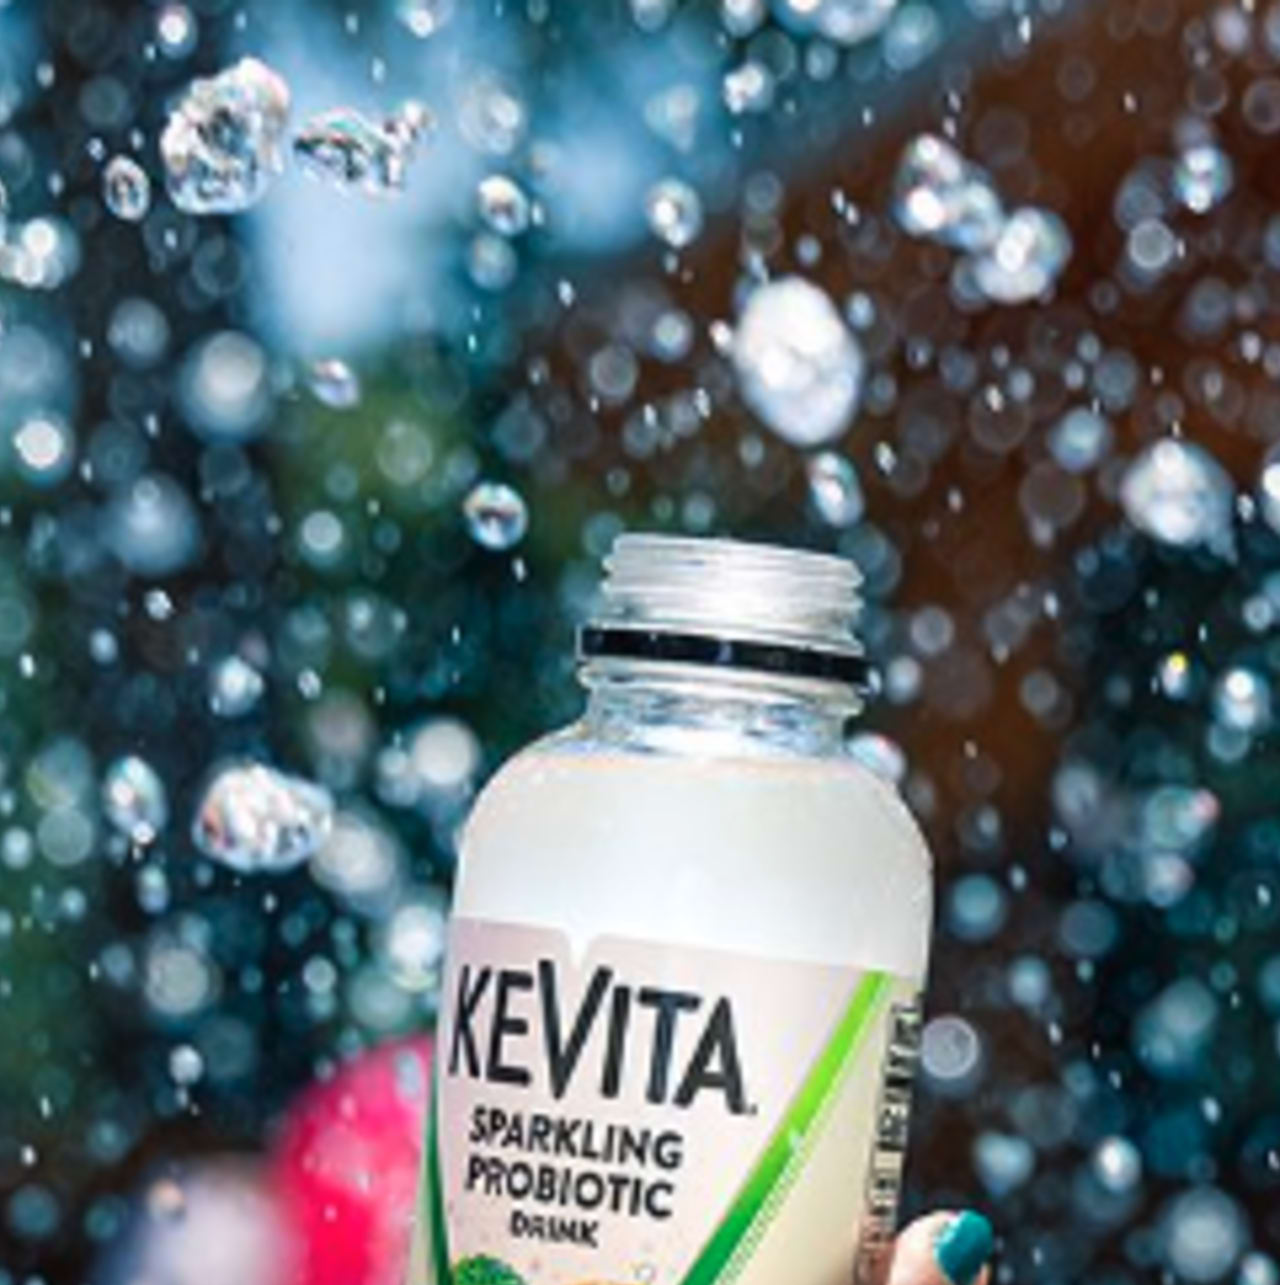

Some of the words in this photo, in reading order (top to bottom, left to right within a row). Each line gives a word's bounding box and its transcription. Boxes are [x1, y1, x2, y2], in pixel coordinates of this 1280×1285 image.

[469, 1105, 684, 1170] SPARKLING
[466, 1154, 674, 1219] PROBIOTIC
[510, 1210, 599, 1247] DRINK
